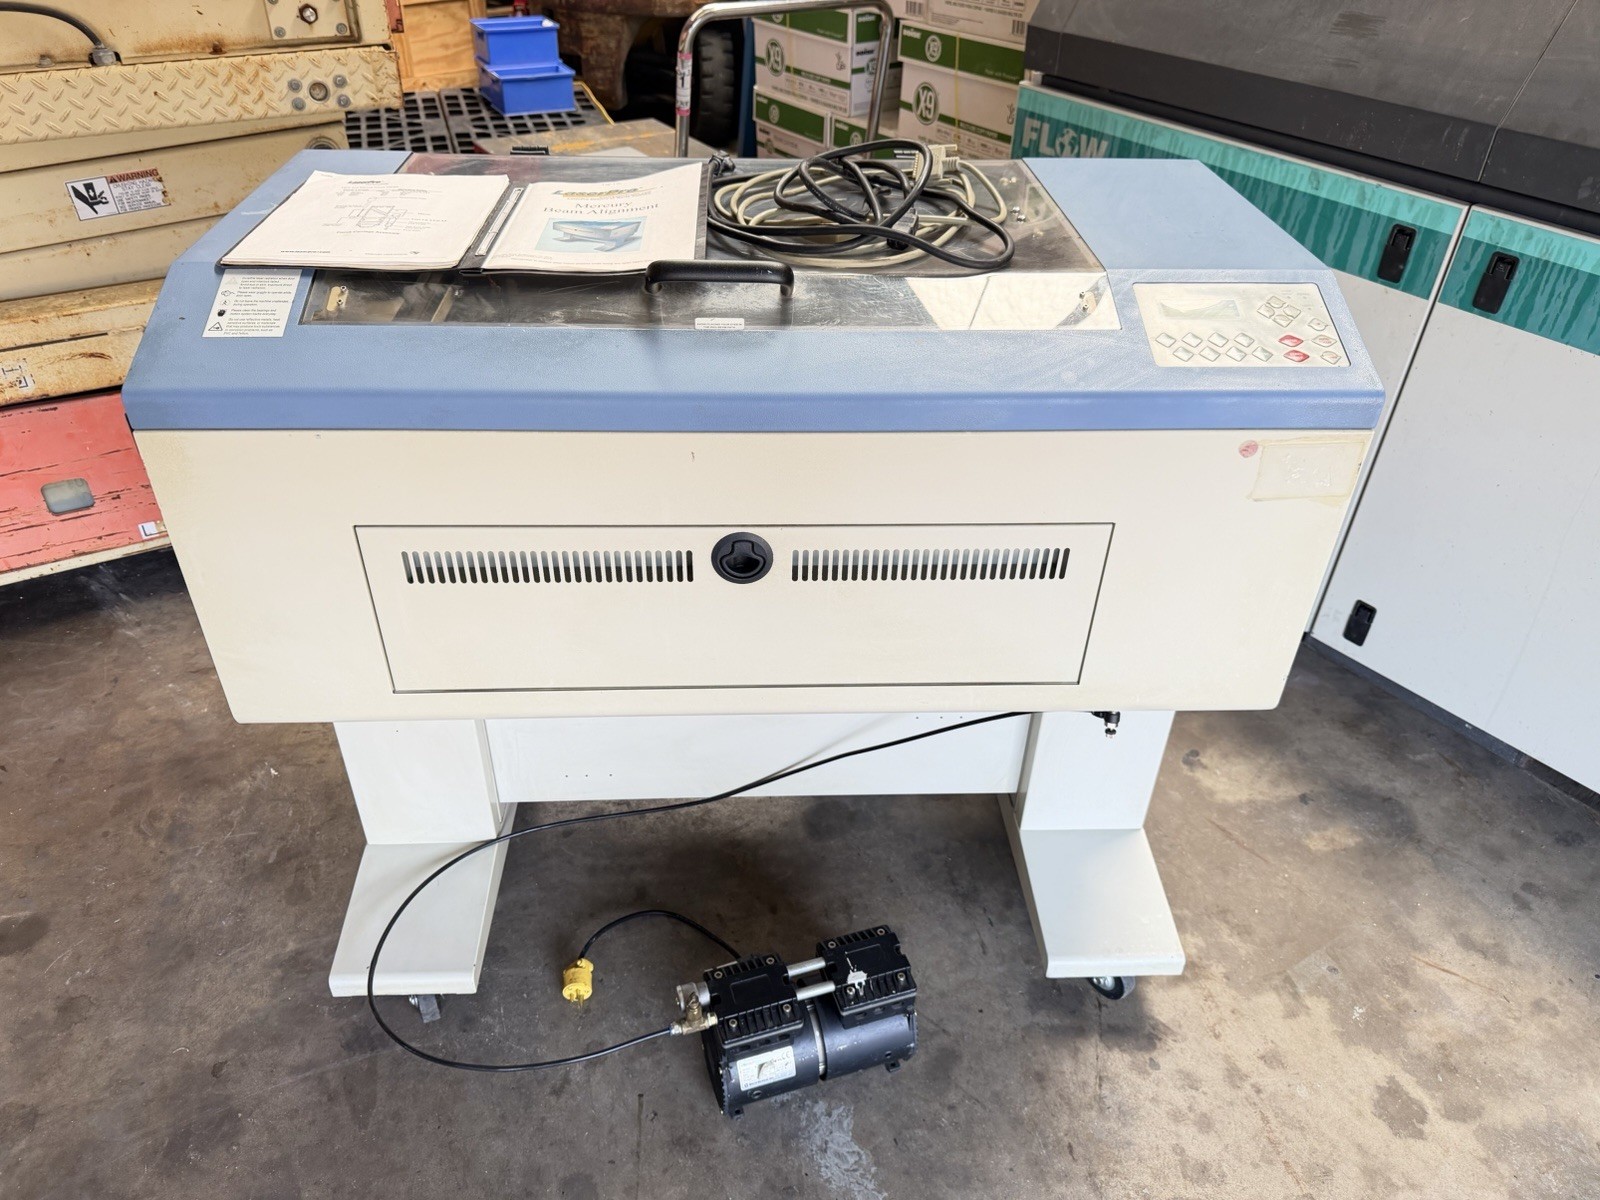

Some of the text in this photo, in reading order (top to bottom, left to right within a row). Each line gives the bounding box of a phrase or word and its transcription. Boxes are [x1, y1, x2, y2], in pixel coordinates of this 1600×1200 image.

[917, 87, 935, 120] X9
[1022, 116, 1108, 158] FLOW
[116, 168, 159, 182] WARNING
[552, 187, 639, 197] LaserPro
[587, 203, 659, 215] Alignment
